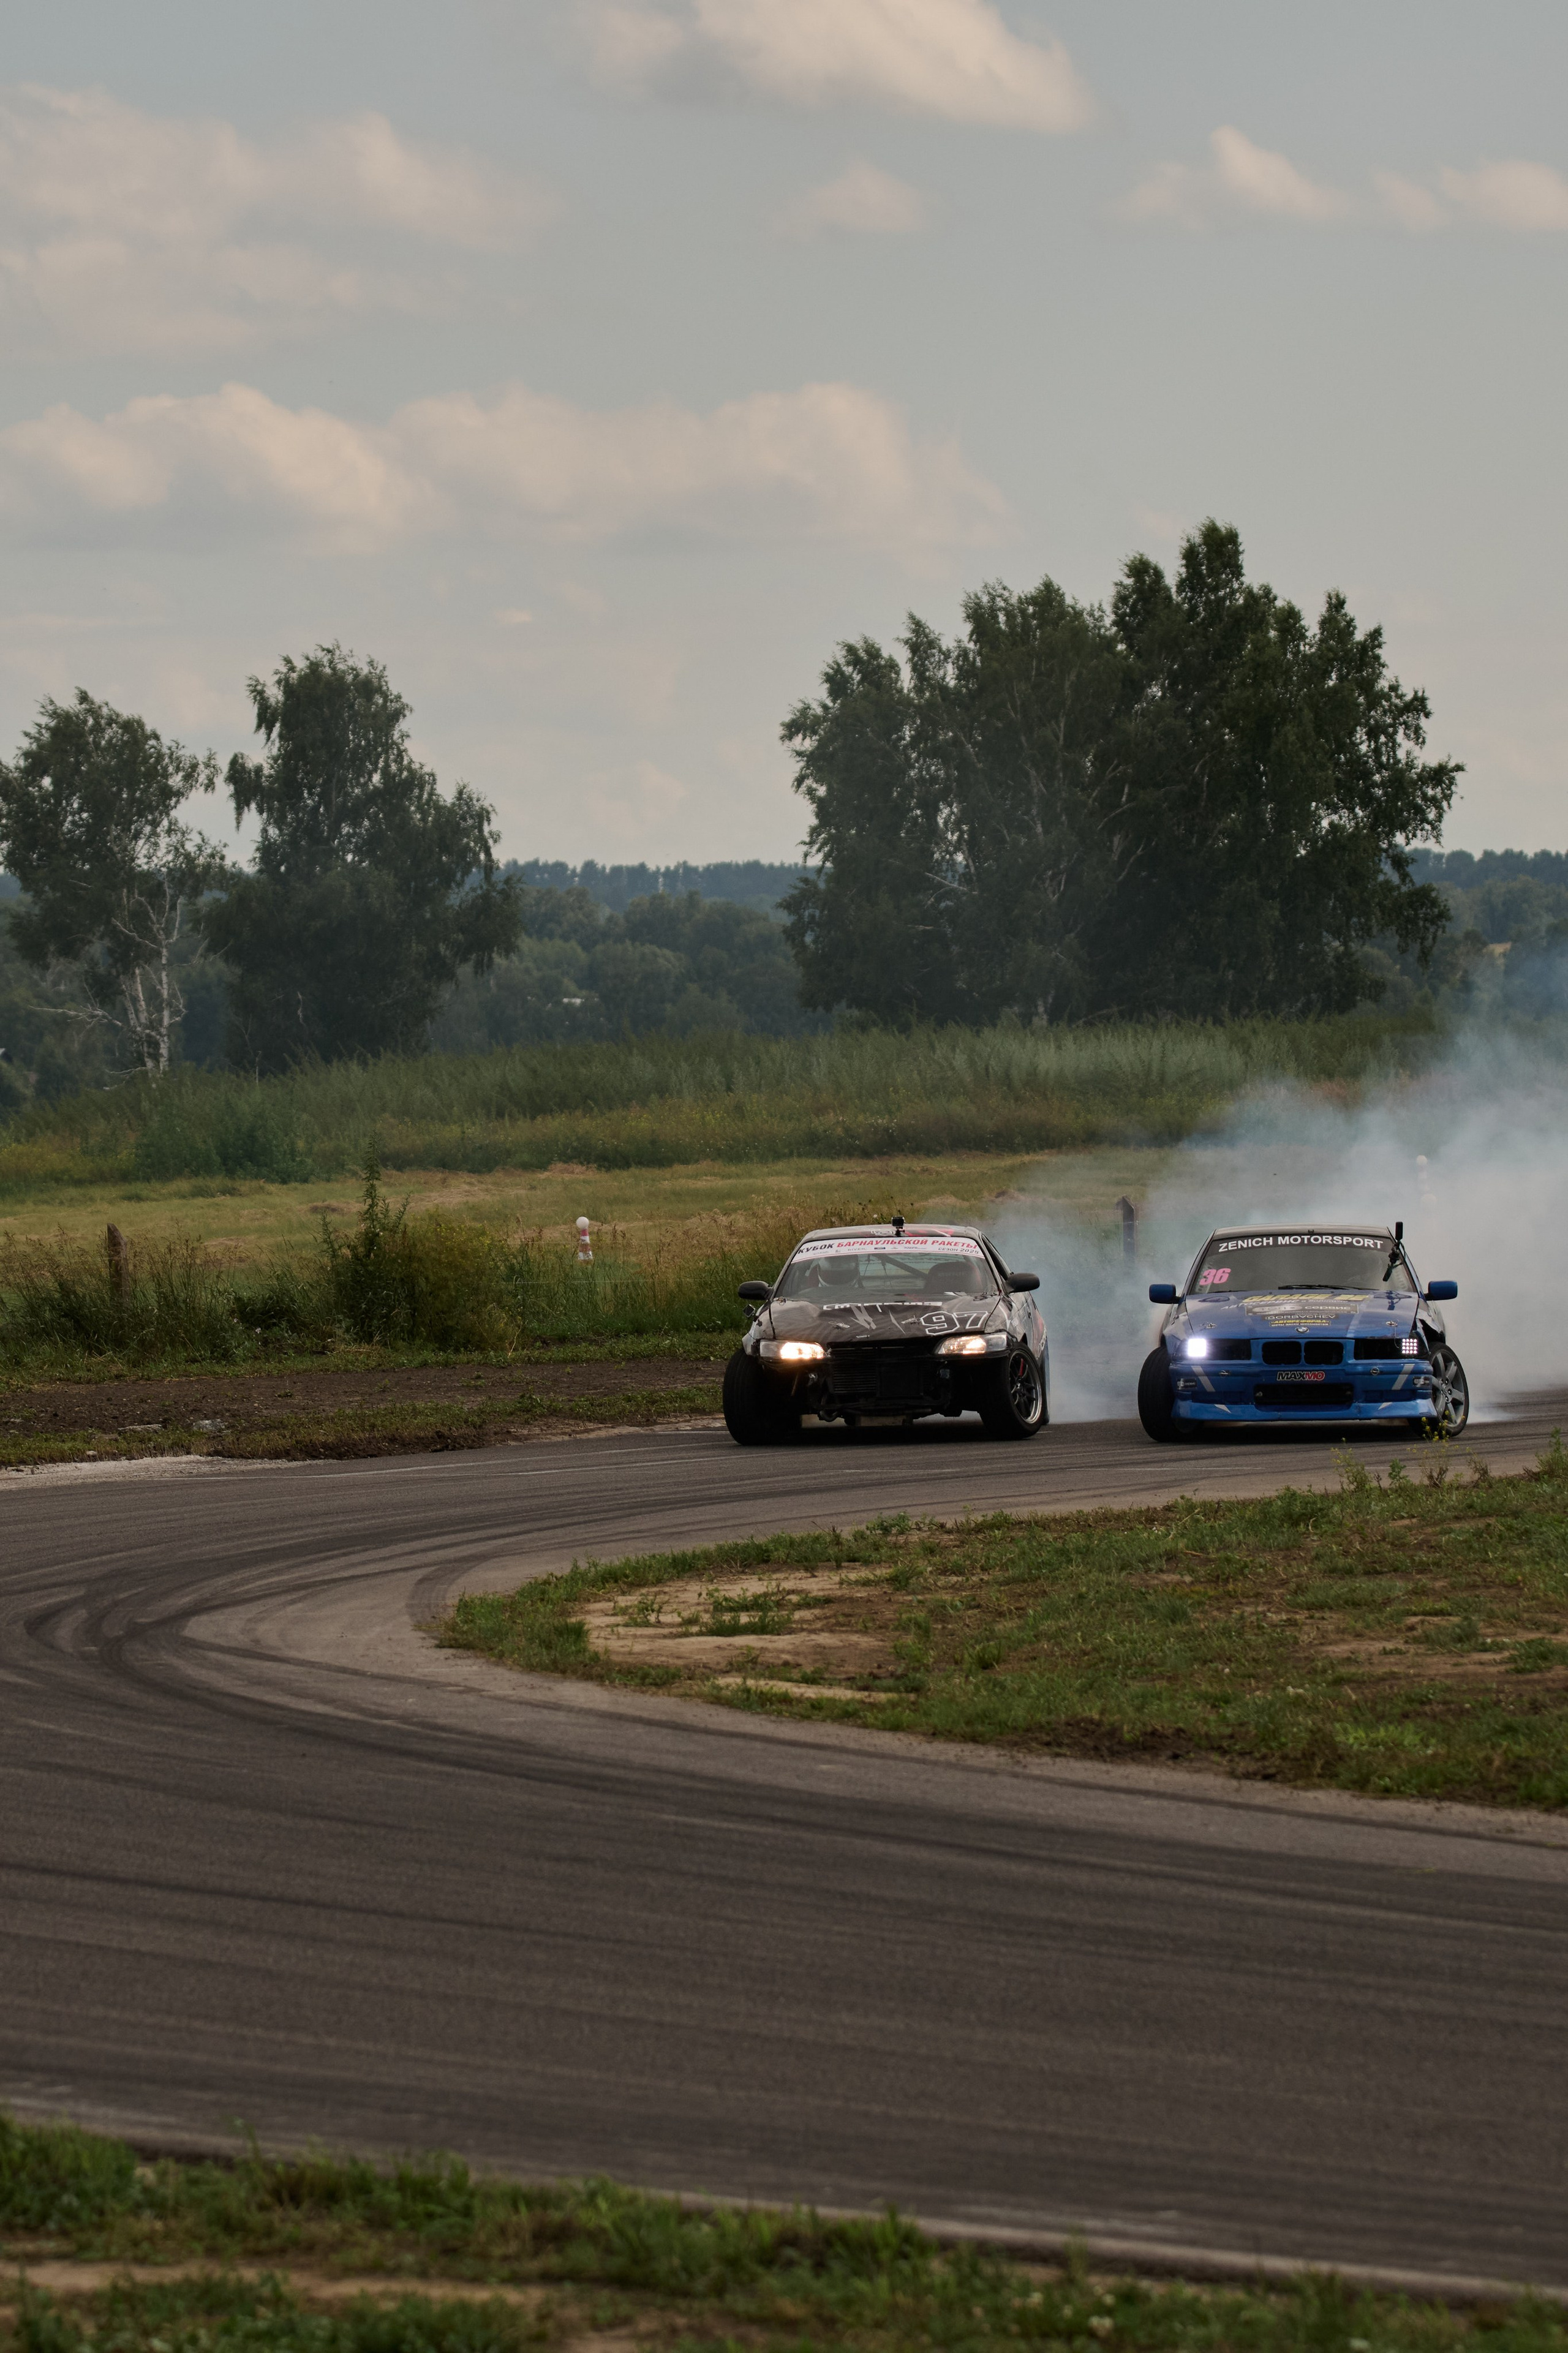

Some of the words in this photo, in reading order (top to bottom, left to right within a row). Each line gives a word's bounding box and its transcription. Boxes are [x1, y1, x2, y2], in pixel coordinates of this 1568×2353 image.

[797, 1243, 835, 1254] КУБОК
[837, 1238, 929, 1248] БАРНАУЛЬСКОЙ
[931, 1240, 978, 1249] РАКЕТЫ
[1218, 1237, 1273, 1252] ZENICH
[1278, 1235, 1384, 1249] MOTORSPORT
[1199, 1268, 1232, 1286] 36
[1242, 1293, 1333, 1303] GARAGE
[920, 1311, 989, 1336] 97
[1276, 1371, 1325, 1380] MAXMO
